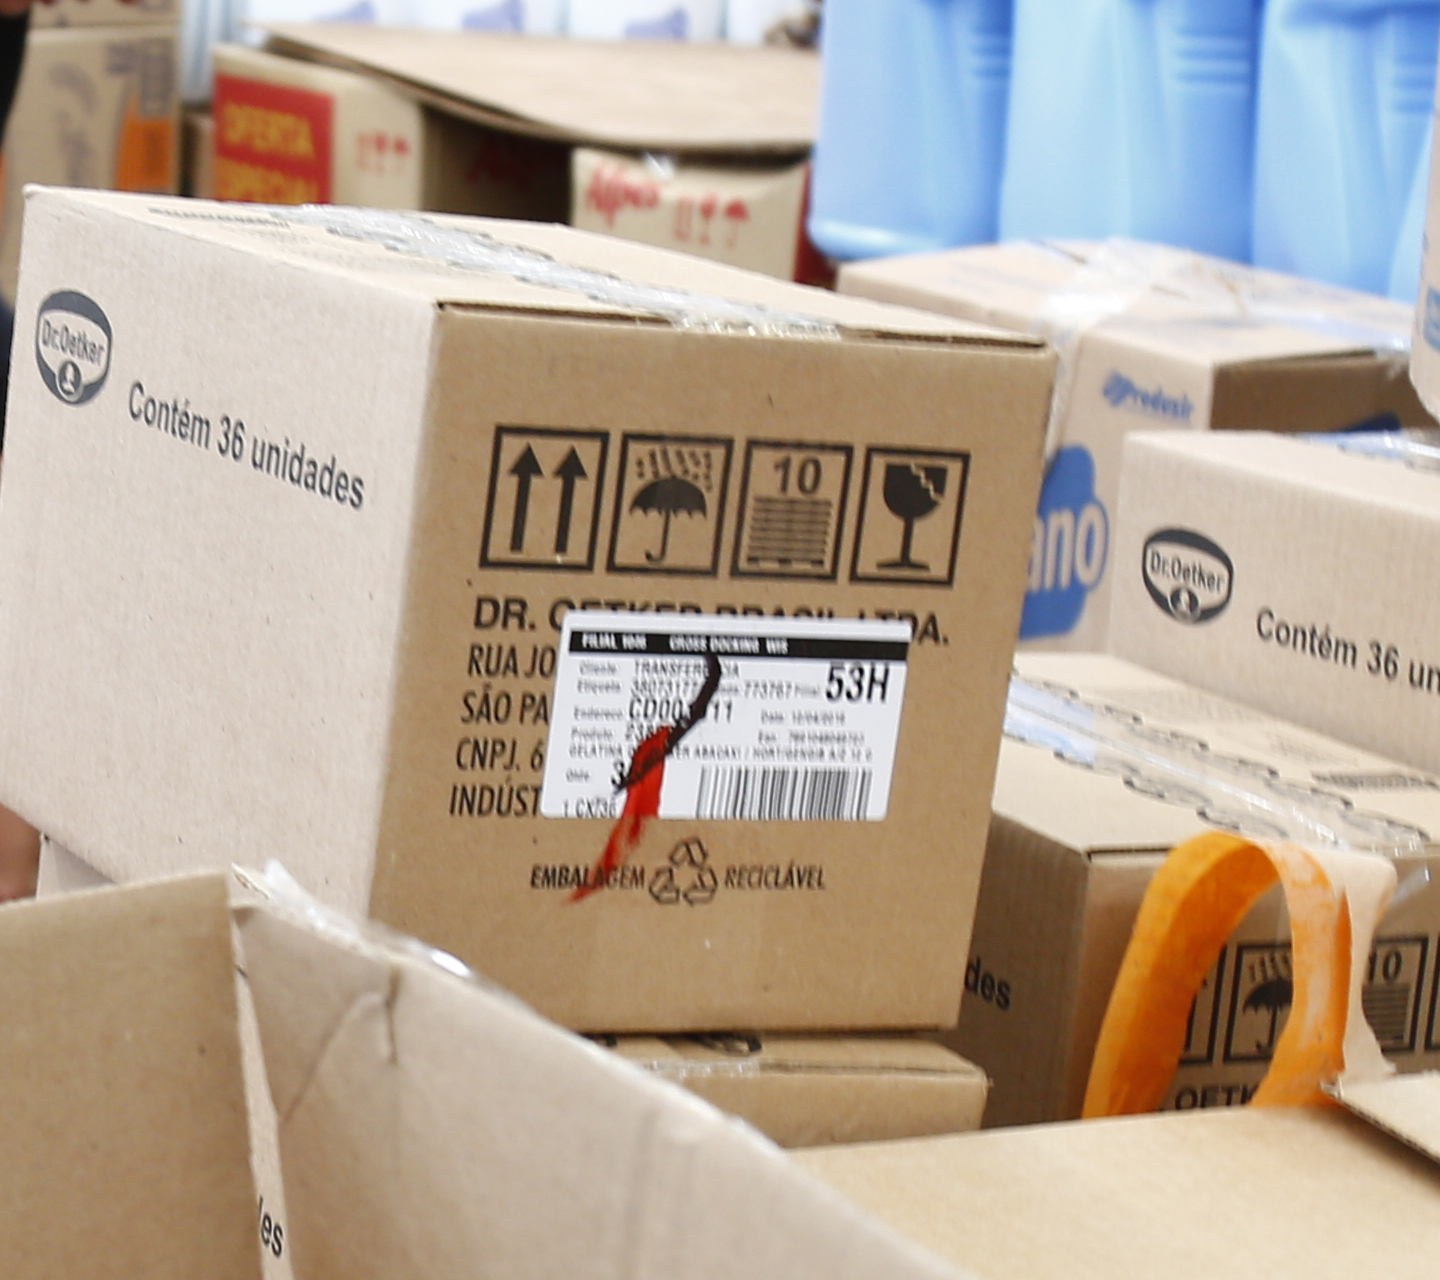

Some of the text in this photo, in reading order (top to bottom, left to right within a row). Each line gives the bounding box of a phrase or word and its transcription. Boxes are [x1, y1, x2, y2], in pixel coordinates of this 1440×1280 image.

[222, 103, 315, 157] OFERTA
[41, 320, 105, 366] Dr.Oetker
[129, 380, 365, 510] Contém 36 unidades
[773, 457, 820, 495] 10
[1149, 546, 1227, 594] Dr.Oetker
[474, 597, 536, 631] DR.
[467, 644, 520, 678] RUA
[581, 632, 760, 654] FILIAL CROSS DOCKING
[1256, 608, 1360, 670] Contém
[1366, 641, 1401, 682] 36
[826, 662, 890, 703] 53H
[461, 684, 516, 723] SÃO
[456, 738, 520, 771] CNPJ.
[531, 862, 826, 892] EMBALAGEM RECICLÁVEL
